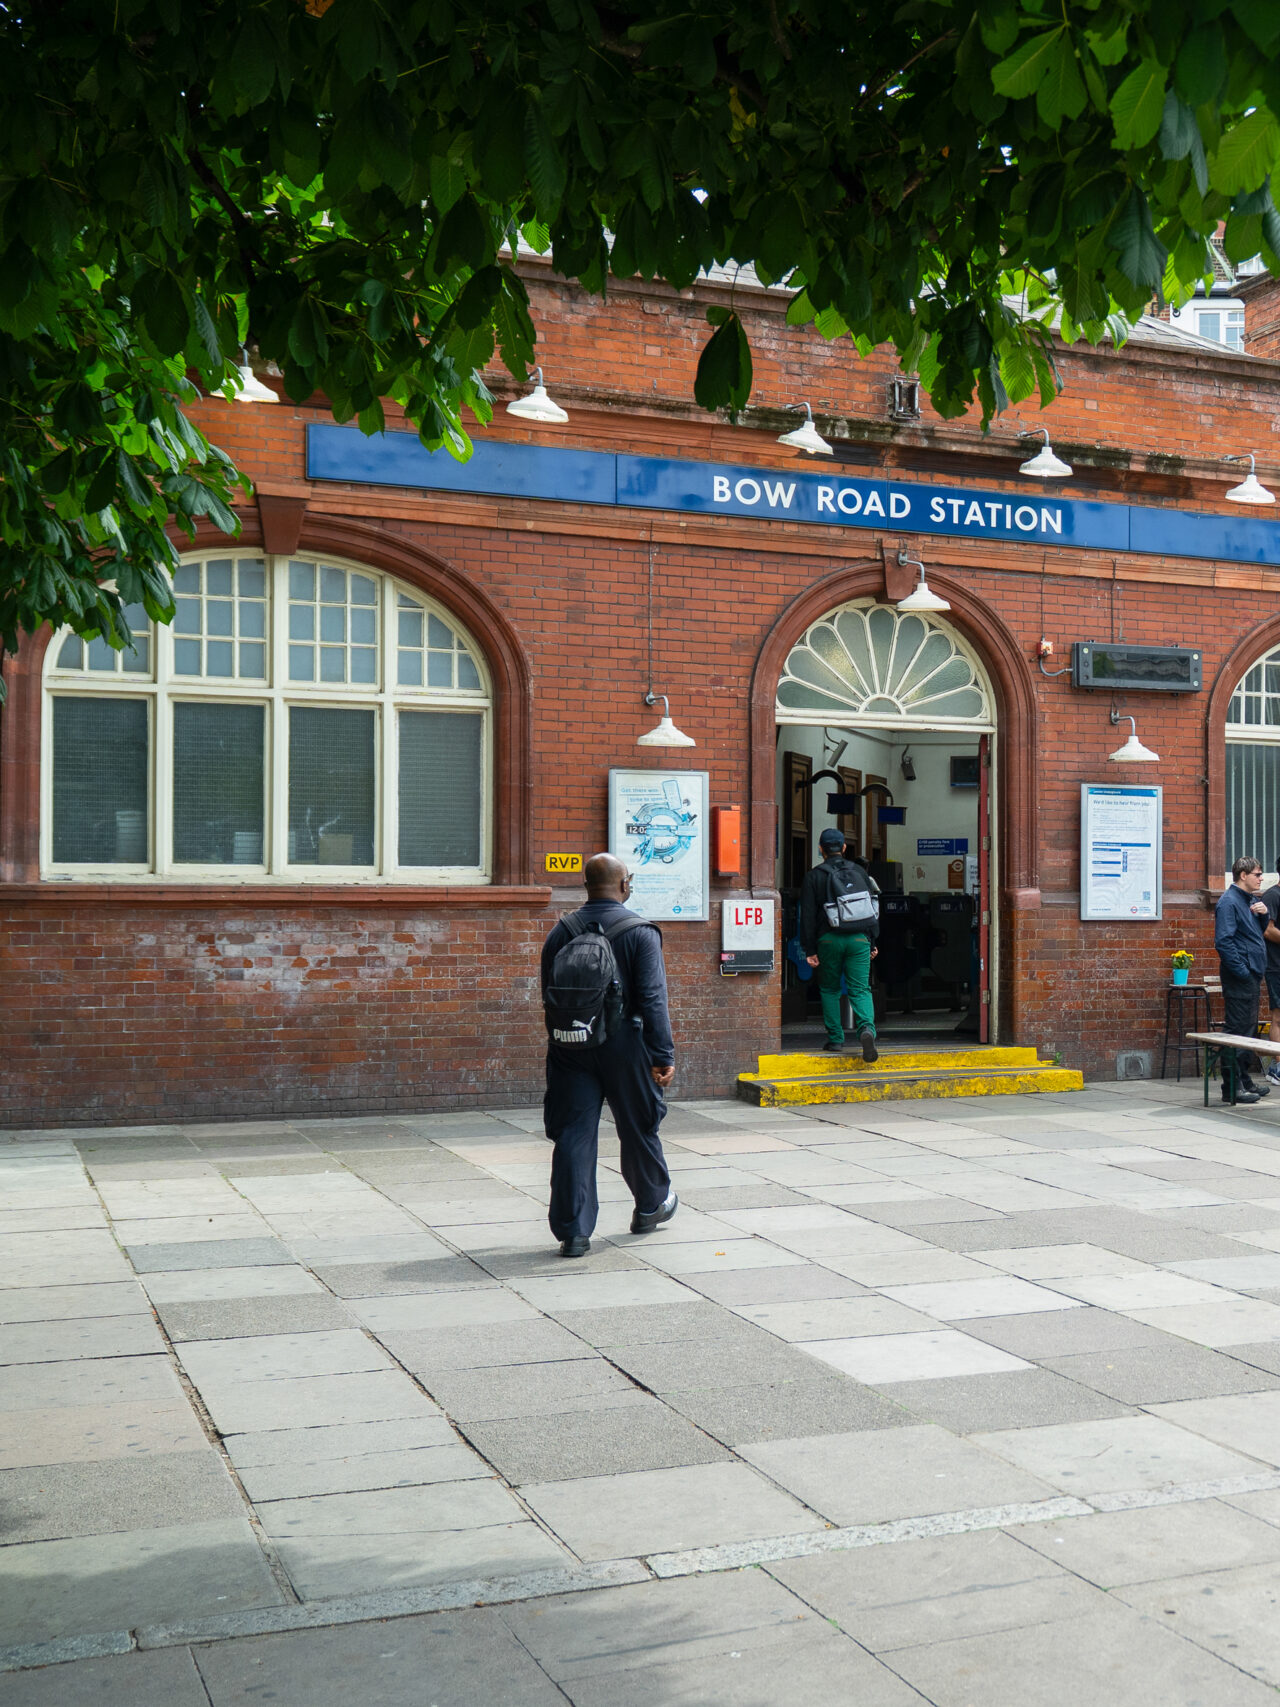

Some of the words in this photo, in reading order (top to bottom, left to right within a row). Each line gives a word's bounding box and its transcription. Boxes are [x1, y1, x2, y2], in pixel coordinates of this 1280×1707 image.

[713, 475, 797, 509] BOW
[817, 485, 912, 519] ROAD
[929, 496, 1062, 534] STATION
[549, 856, 580, 870] RVP
[735, 907, 763, 926] LFB
[553, 1028, 587, 1043] PUMA
